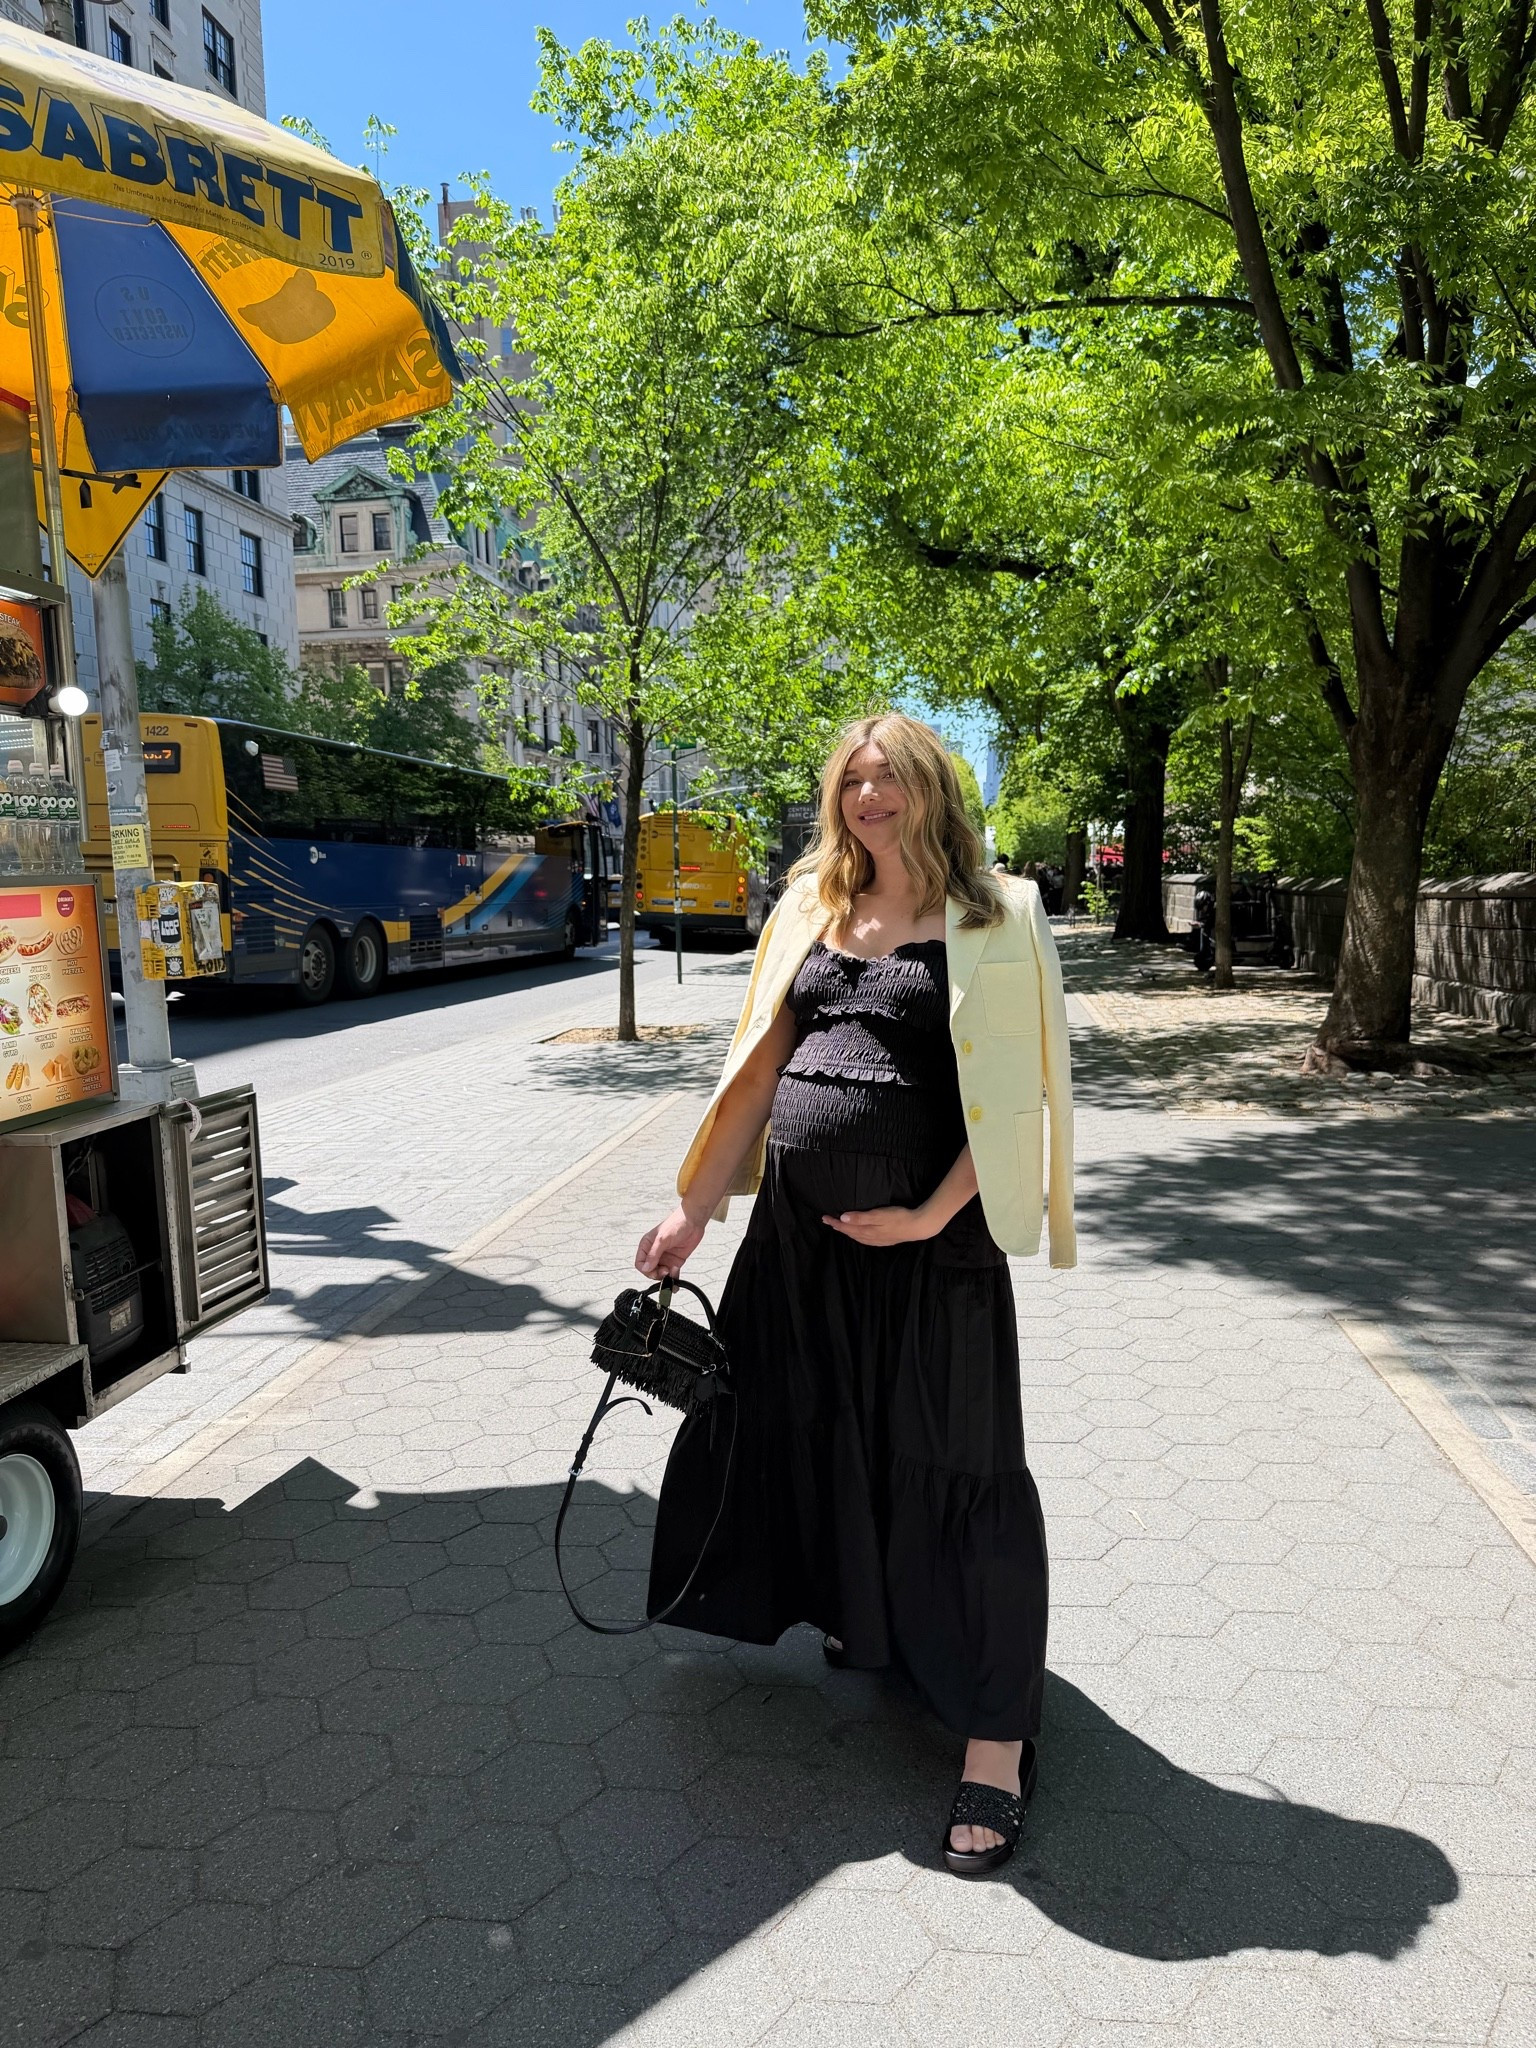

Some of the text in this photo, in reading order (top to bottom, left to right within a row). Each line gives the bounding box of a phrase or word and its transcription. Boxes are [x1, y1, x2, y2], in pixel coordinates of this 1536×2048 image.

[0, 78, 363, 253] SABRETT
[112, 183, 125, 193] This
[126, 187, 154, 200] Umbrella
[174, 198, 199, 214] Property
[318, 252, 355, 269] 2019
[0, 612, 21, 628] STEAK
[145, 725, 169, 736] 1422
[112, 828, 140, 838] ARKING
[465, 854, 477, 867] NY
[0, 967, 20, 975] CHEESE
[62, 967, 85, 975] PRETZEL
[70, 1026, 91, 1035] ITALIAN
[35, 1032, 57, 1042] CHICKEN
[69, 1034, 93, 1043] SAUSAGE
[81, 1075, 100, 1083] CHEESE
[57, 1085, 68, 1093] HOT
[82, 1083, 102, 1093] PRETZEL
